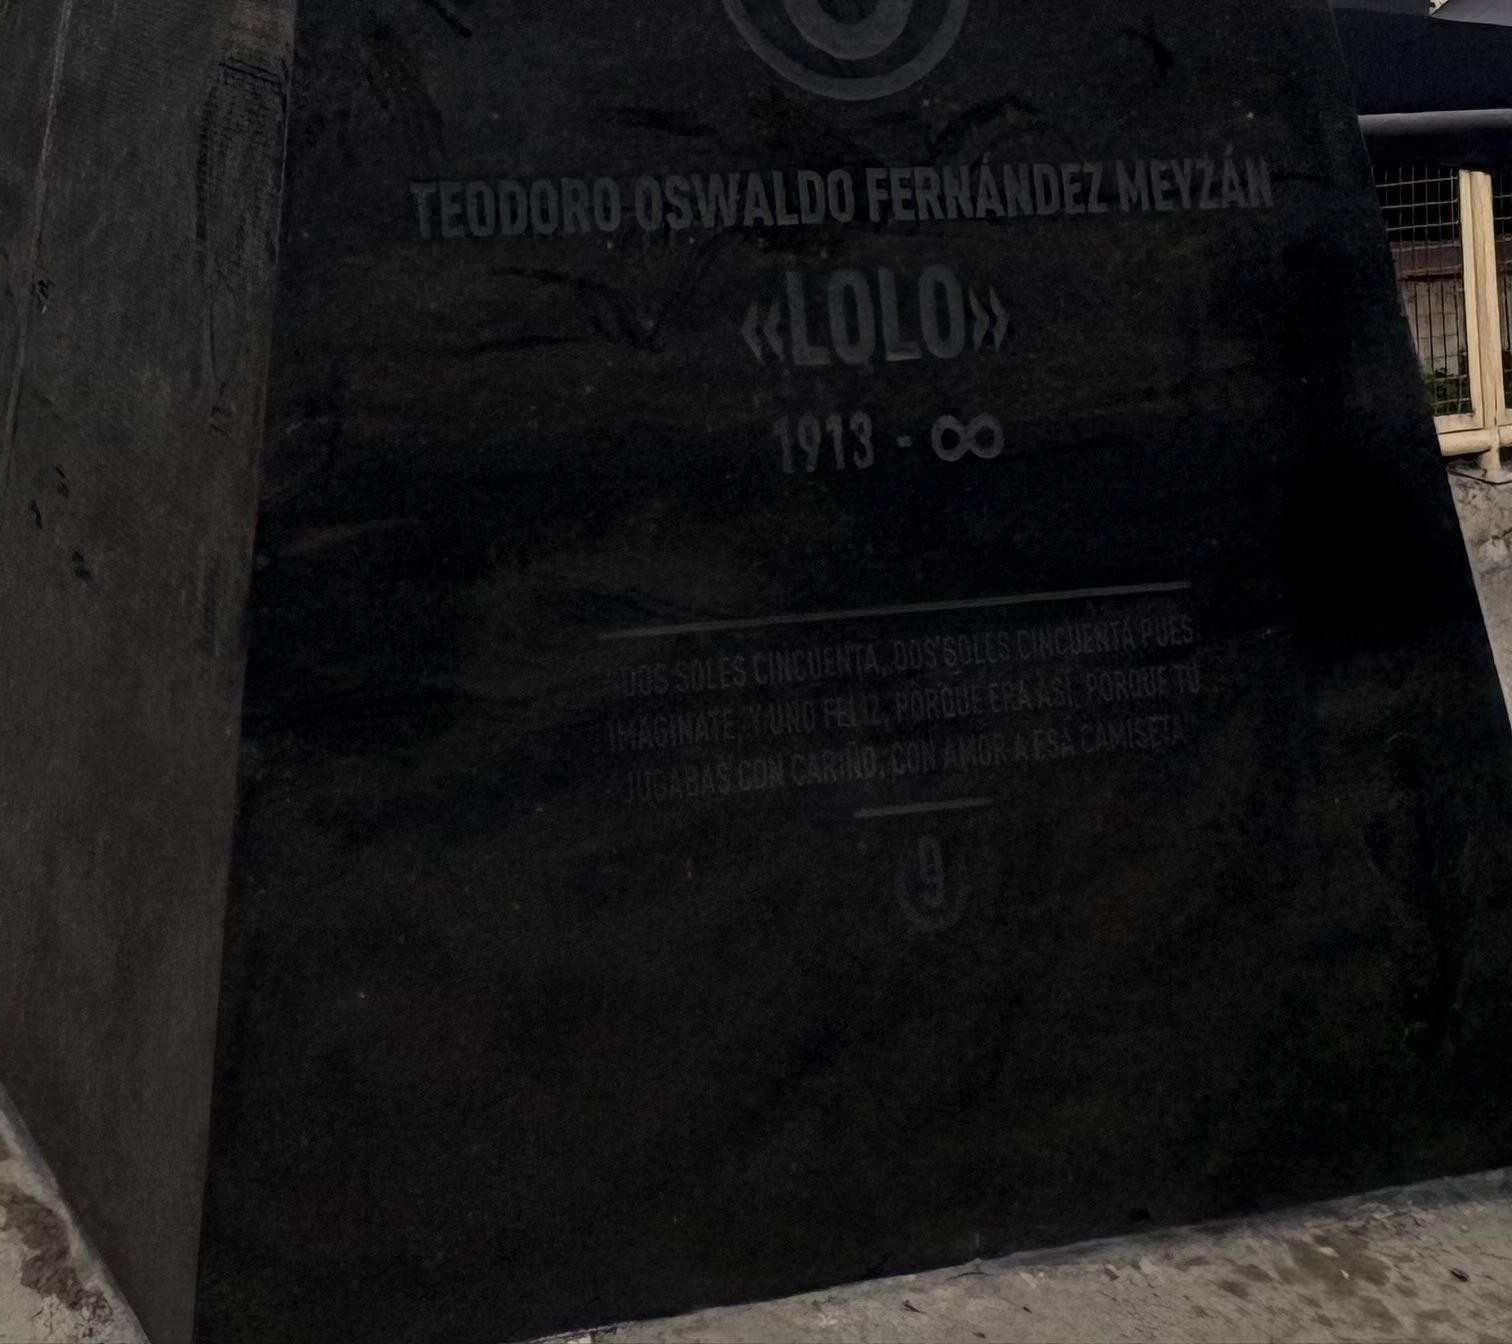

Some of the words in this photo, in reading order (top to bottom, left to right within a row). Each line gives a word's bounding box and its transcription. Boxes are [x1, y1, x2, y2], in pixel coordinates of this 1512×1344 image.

[410, 174, 622, 243] TEODORO
[633, 166, 856, 233] OSWALDO
[867, 152, 1109, 224] FERNÁNDEZ
[1119, 144, 1275, 215] MEYZÁN
[772, 411, 876, 474] 1913
